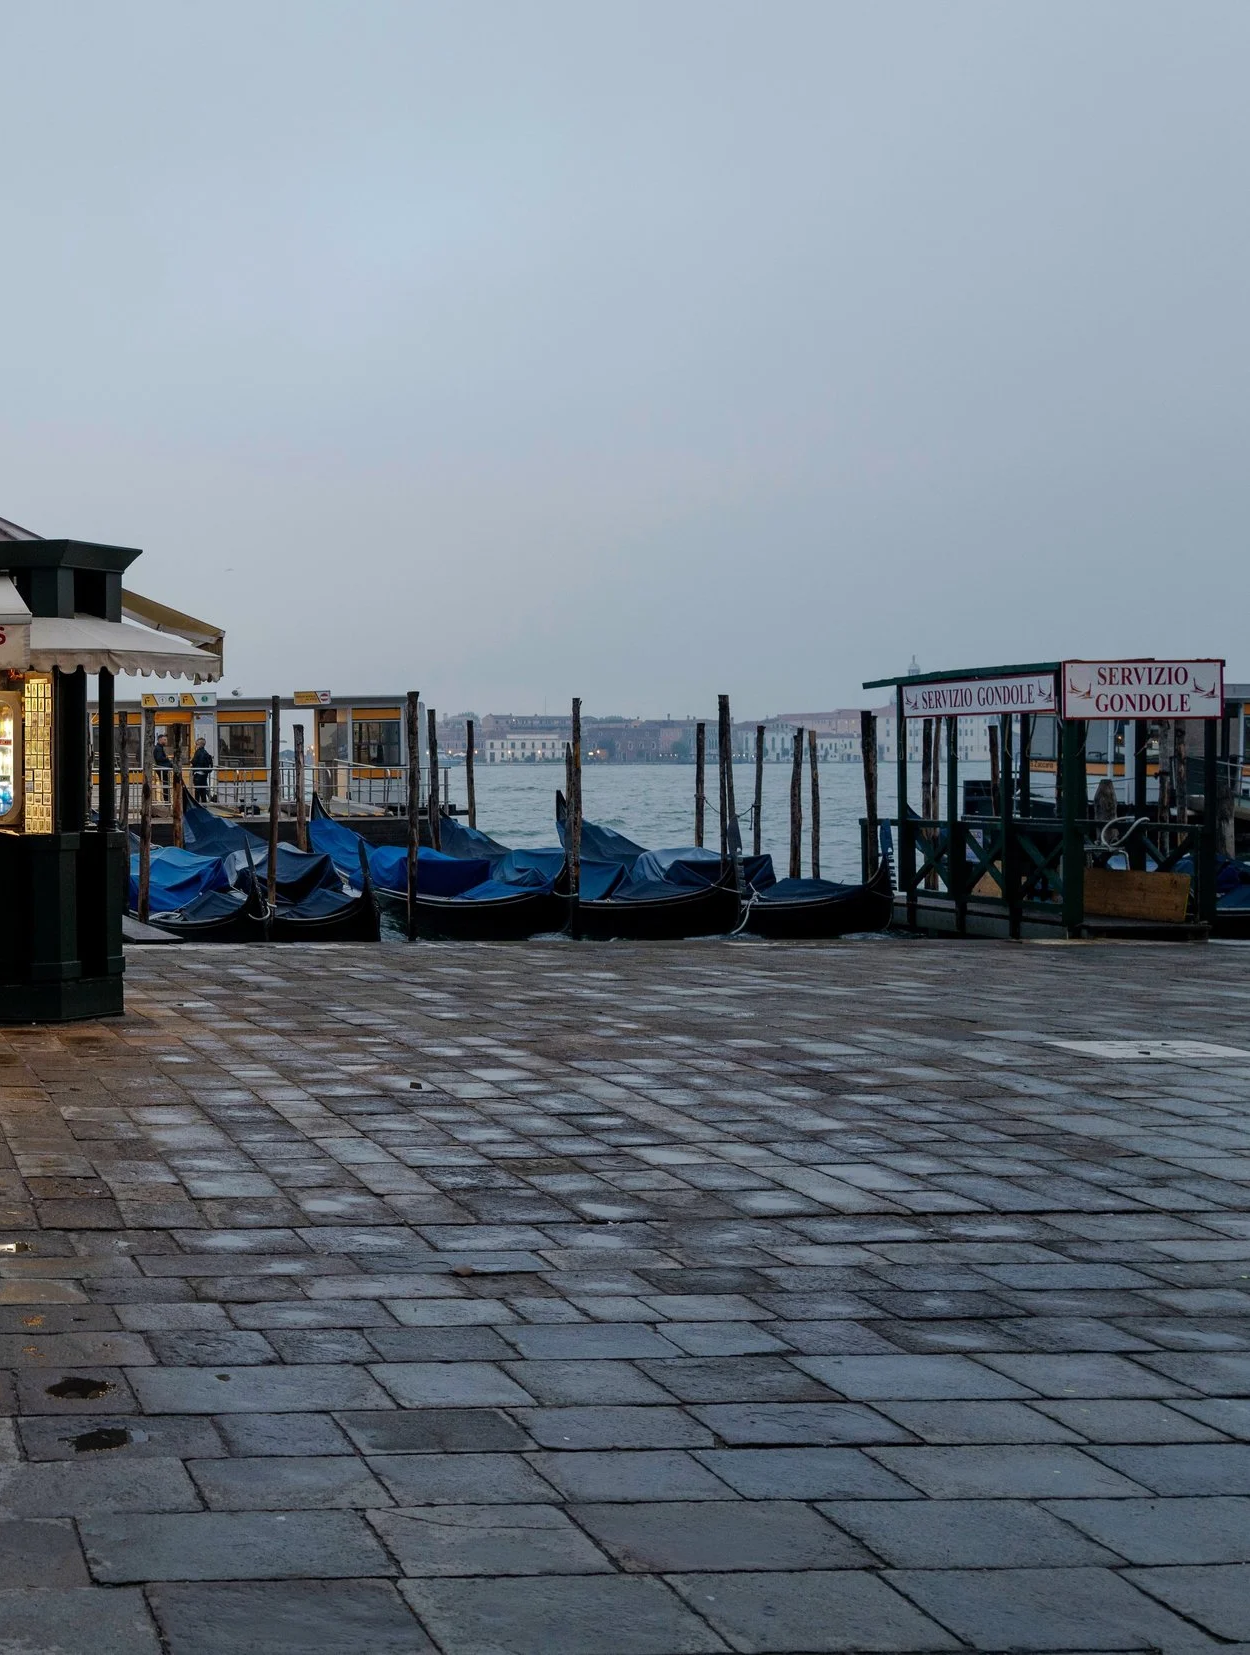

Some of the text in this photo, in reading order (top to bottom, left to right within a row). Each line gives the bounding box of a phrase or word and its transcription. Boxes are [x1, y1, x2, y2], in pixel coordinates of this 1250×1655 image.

[1097, 666, 1189, 685] SERVIZIO
[921, 684, 1035, 710] SERVIZIO GONDOLE
[1095, 693, 1191, 713] GONDOLE
